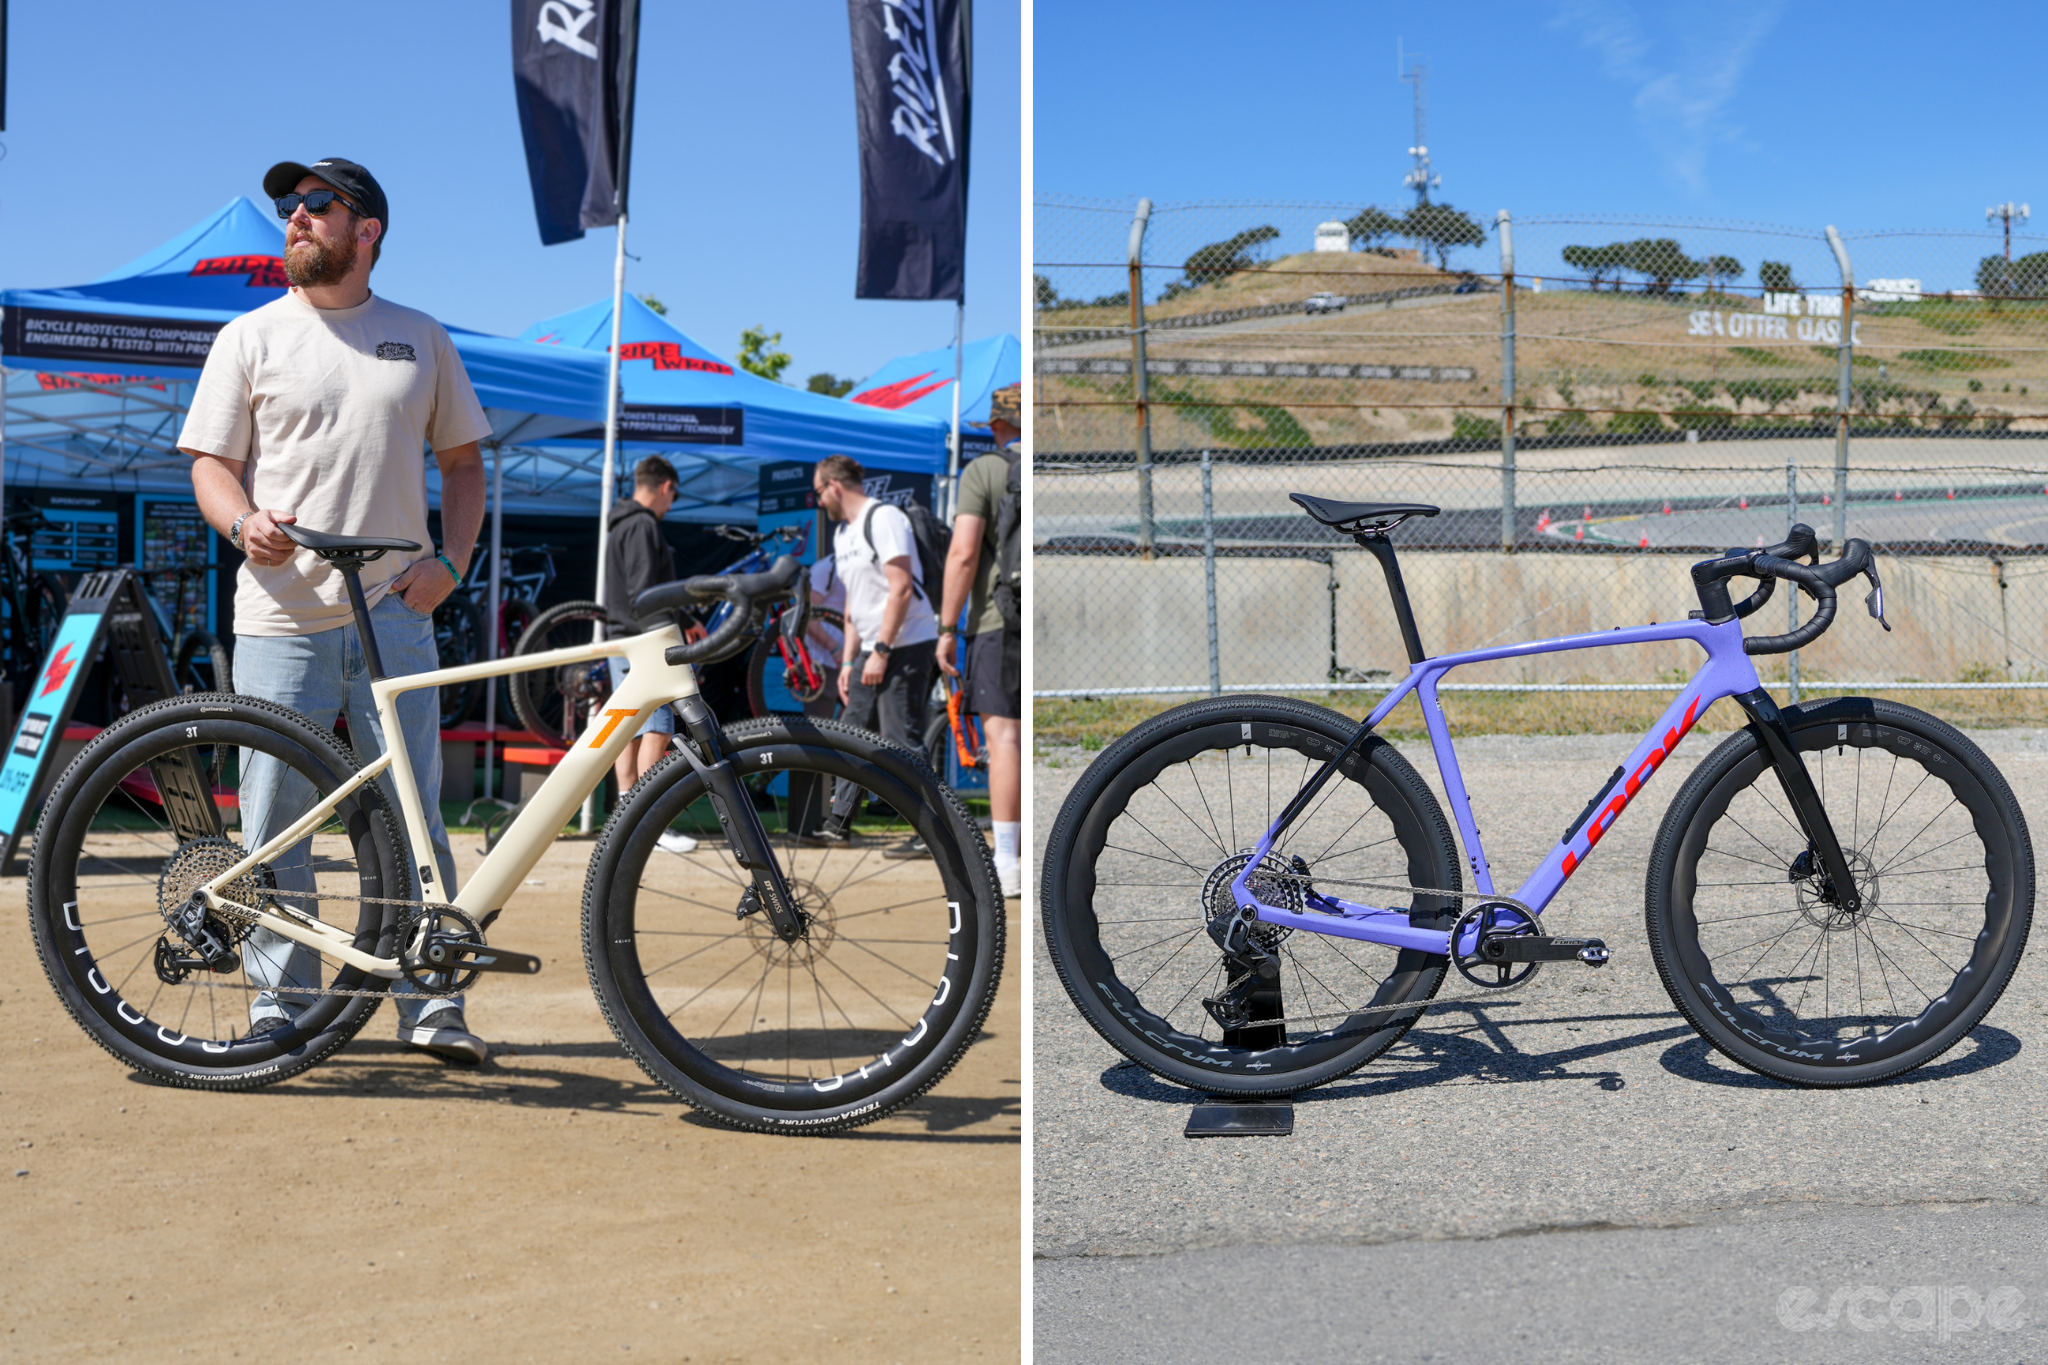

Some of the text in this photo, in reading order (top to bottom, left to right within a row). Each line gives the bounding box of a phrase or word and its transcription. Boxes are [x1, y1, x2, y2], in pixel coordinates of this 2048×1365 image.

[1764, 291, 1801, 315] LIFE
[25, 318, 220, 343] BICYCLE PROTECTION COMPONENT
[1687, 310, 1862, 345] SEA OTTER CLASC
[25, 332, 99, 348] ENGINEERED
[100, 337, 110, 348] &
[111, 338, 153, 351] TESTED
[154, 341, 184, 353] WITH
[628, 422, 684, 432] PROPRIETARY
[683, 424, 736, 435] TECHNOLOGY
[185, 726, 198, 738] 3T
[760, 752, 773, 765] 3T
[763, 880, 784, 914] DT SWISS
[219, 902, 262, 920] RIDEWRAP
[188, 1073, 243, 1081] ADVENTURE
[243, 1064, 280, 1079] TERRA
[840, 1101, 882, 1120] TERRA
[778, 1114, 841, 1126] ADVENTURE
